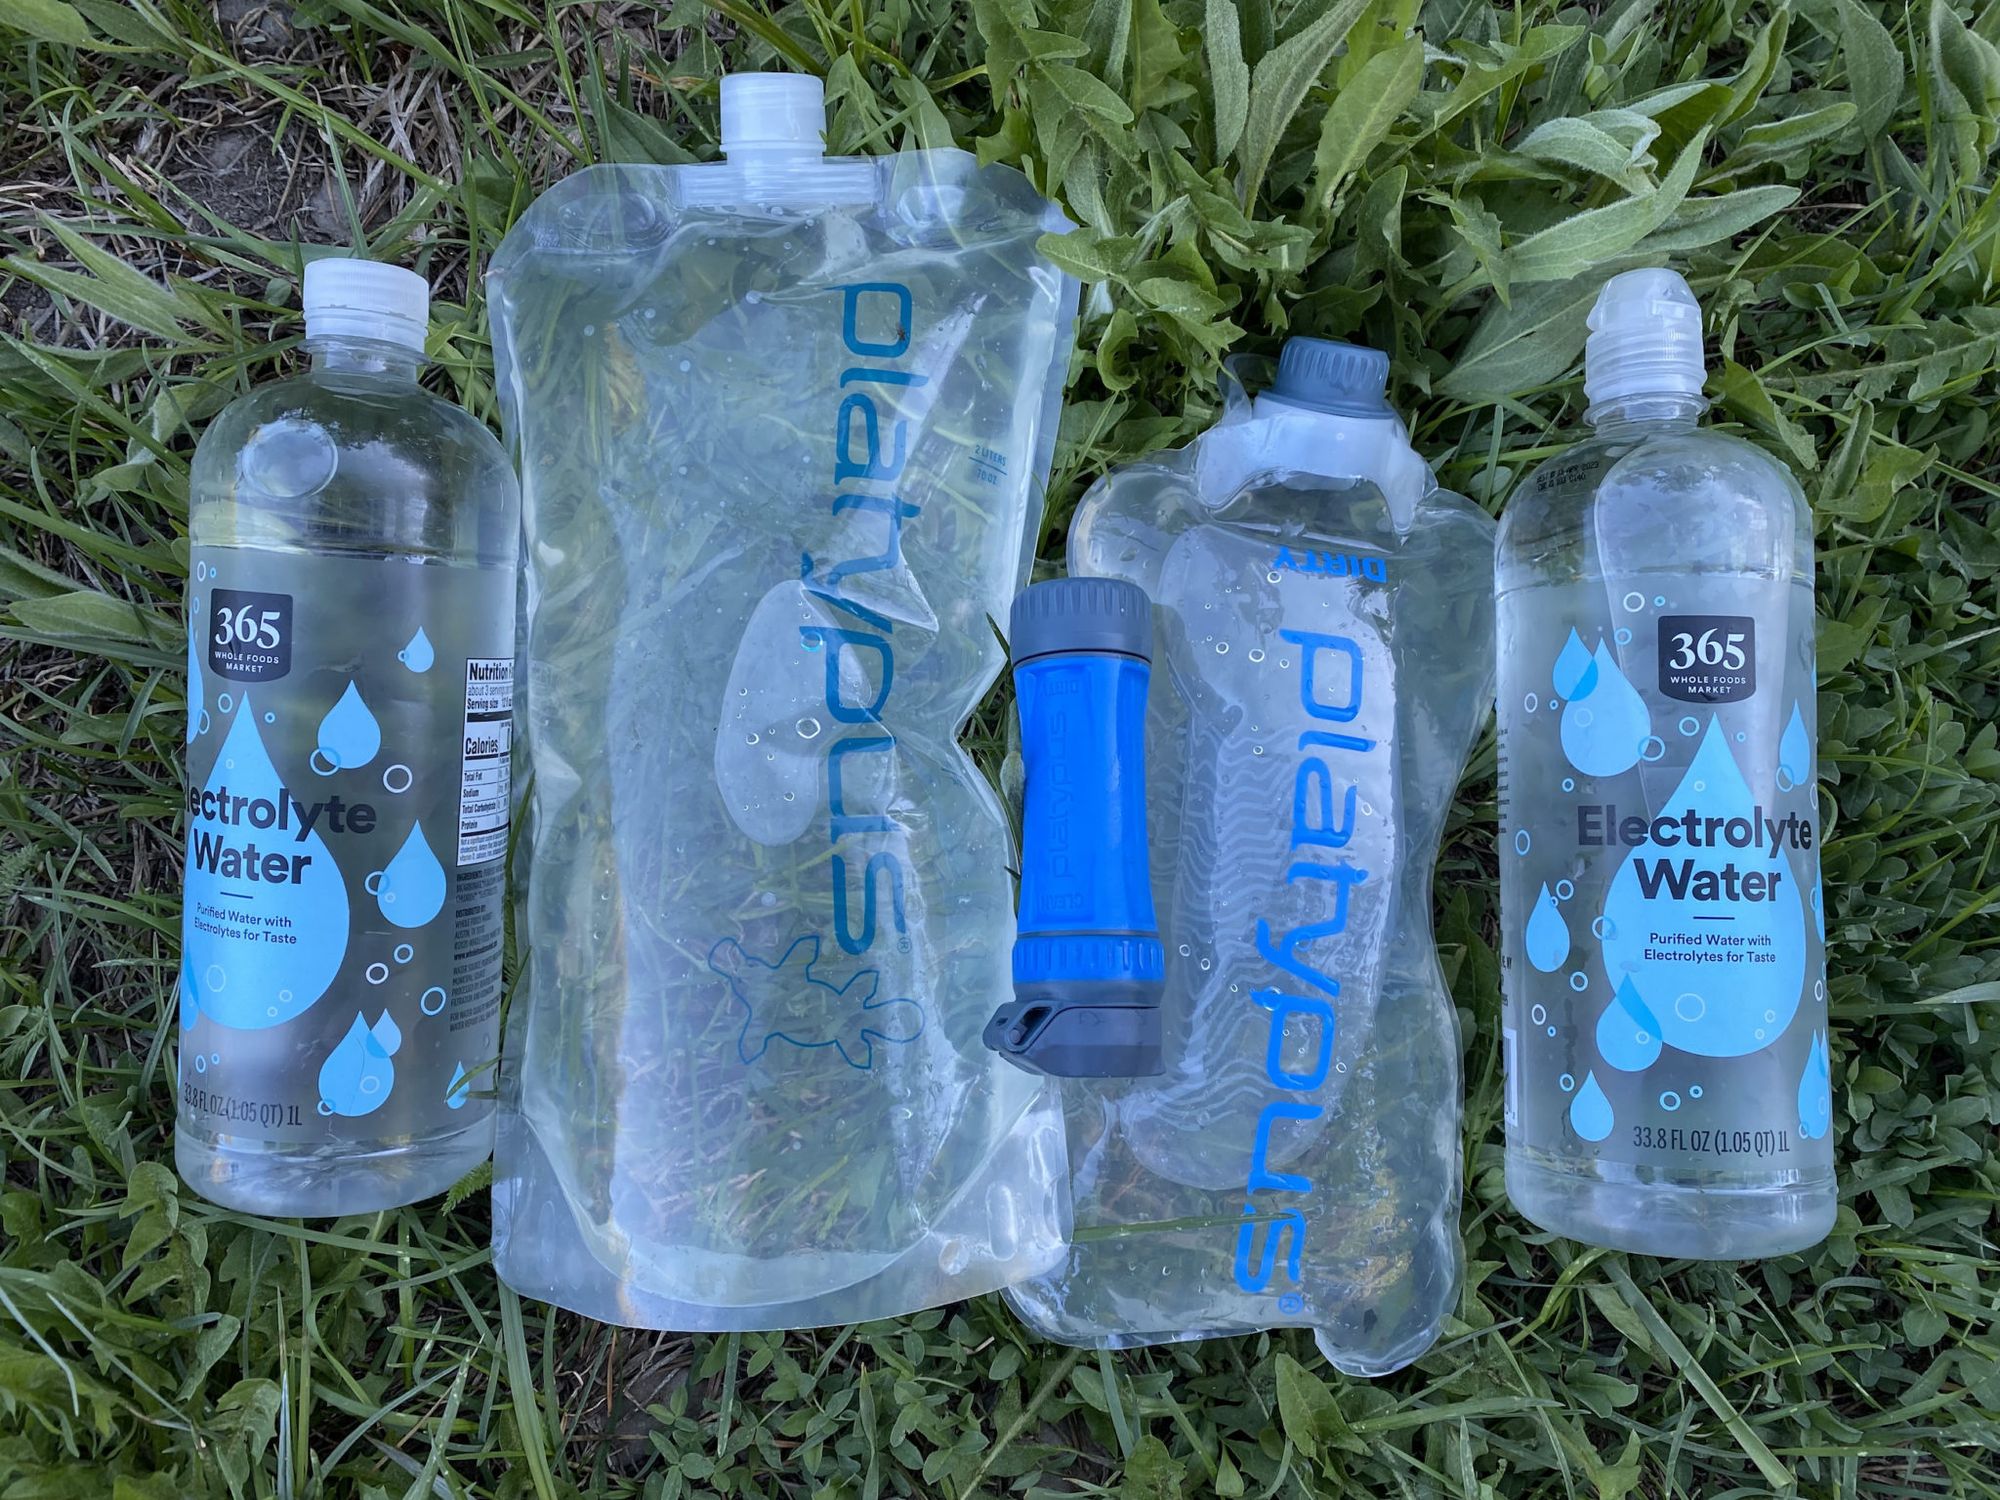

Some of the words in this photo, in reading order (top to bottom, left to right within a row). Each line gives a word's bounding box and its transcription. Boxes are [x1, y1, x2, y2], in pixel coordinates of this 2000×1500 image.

[981, 448, 1007, 467] LITERS
[1272, 545, 1387, 584] DIRTY
[215, 604, 281, 649] 365
[800, 282, 929, 955] platypus
[214, 650, 244, 662] WHOLE
[246, 653, 280, 665] FOODS
[1669, 627, 1746, 670] 365
[225, 662, 264, 674] MARKET
[469, 662, 508, 681] Nutrition
[1670, 675, 1709, 685] WHOLE
[1713, 675, 1747, 685] FOODS
[1687, 685, 1732, 695] MARKET
[466, 697, 488, 711] Serving
[465, 736, 499, 756] Calories
[463, 771, 475, 782] Total
[475, 771, 483, 781] Fat
[462, 788, 480, 799] Sodium
[187, 772, 377, 842] lectrolyte
[462, 804, 474, 815] Total
[461, 820, 478, 831] Protein
[1577, 804, 1812, 859] Electrolyte
[193, 828, 313, 885] Water
[1633, 858, 1782, 902] Water
[197, 901, 226, 920] Purified
[228, 909, 262, 926] Water
[264, 915, 292, 928] with
[194, 916, 241, 939] Electrolytes
[243, 928, 260, 941] for
[262, 930, 297, 945] Taste
[1649, 932, 1702, 946] Purified
[1705, 934, 1745, 947] Water
[1747, 934, 1772, 947] with
[1234, 628, 1377, 1294] platypus
[1643, 948, 1724, 965] Electrolytes
[1726, 950, 1745, 963] for
[1746, 951, 1777, 963] Taste
[199, 1090, 208, 1112] FL
[210, 1094, 226, 1117] OZ
[226, 1097, 257, 1122] (1.05
[260, 1103, 284, 1129] QT)
[287, 1104, 303, 1127] 1L
[1633, 1126, 1667, 1150] 33.8
[1671, 1129, 1687, 1151] FL
[1691, 1130, 1711, 1152] OZ
[1714, 1129, 1751, 1156] (1.05
[1754, 1130, 1775, 1158] QT)
[1778, 1130, 1790, 1152] 1L
